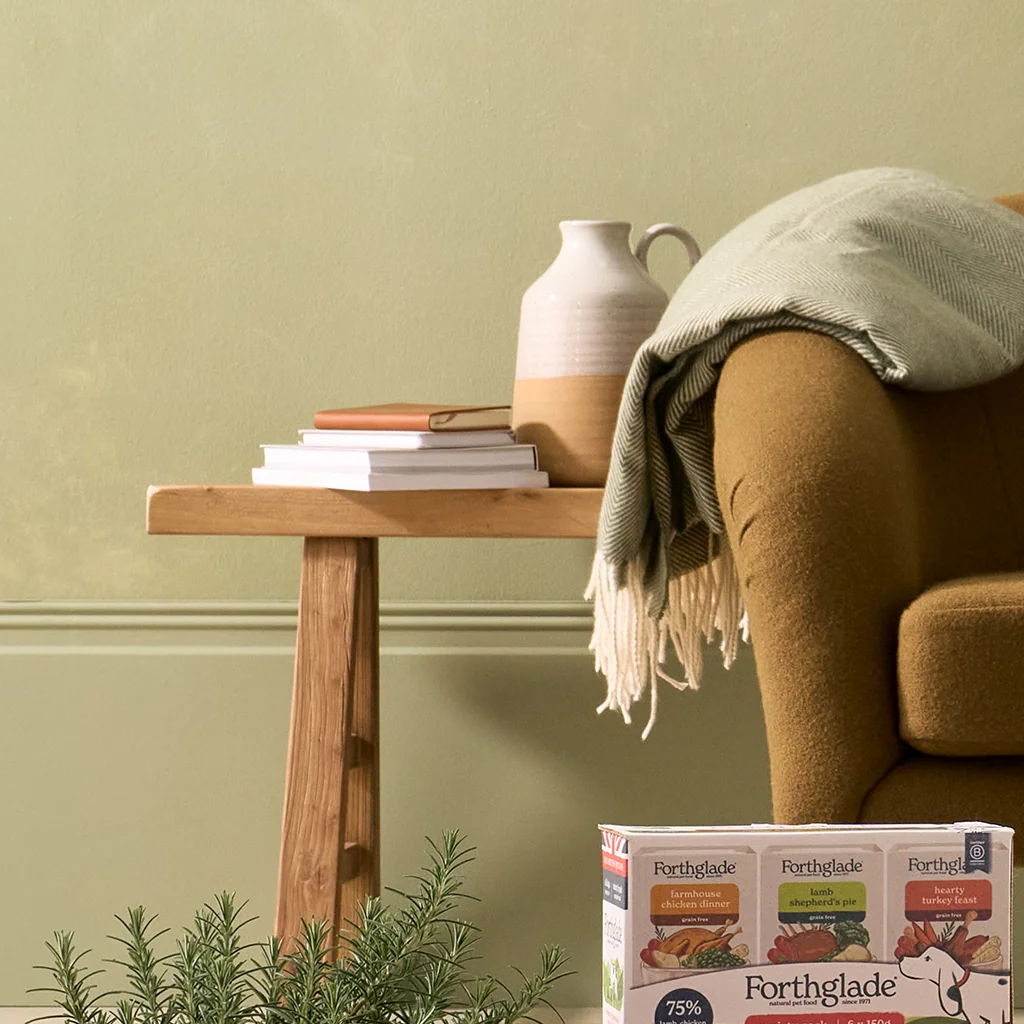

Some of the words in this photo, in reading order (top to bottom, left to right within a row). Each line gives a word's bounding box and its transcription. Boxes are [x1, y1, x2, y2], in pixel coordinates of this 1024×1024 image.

[654, 860, 736, 879] Forthglade
[782, 858, 863, 877] Forthglade
[908, 857, 966, 875] Forthgl
[671, 890, 721, 898] farmhouse
[810, 888, 834, 896] lamb
[934, 886, 965, 895] hearty
[661, 900, 697, 908] chicken
[699, 900, 731, 908] dinner
[789, 898, 841, 907] shepherd's
[842, 898, 857, 907] pie
[922, 896, 952, 905] turkey
[954, 895, 977, 904] feast
[745, 972, 896, 1007] Forthglade
[666, 1000, 702, 1016] 75%
